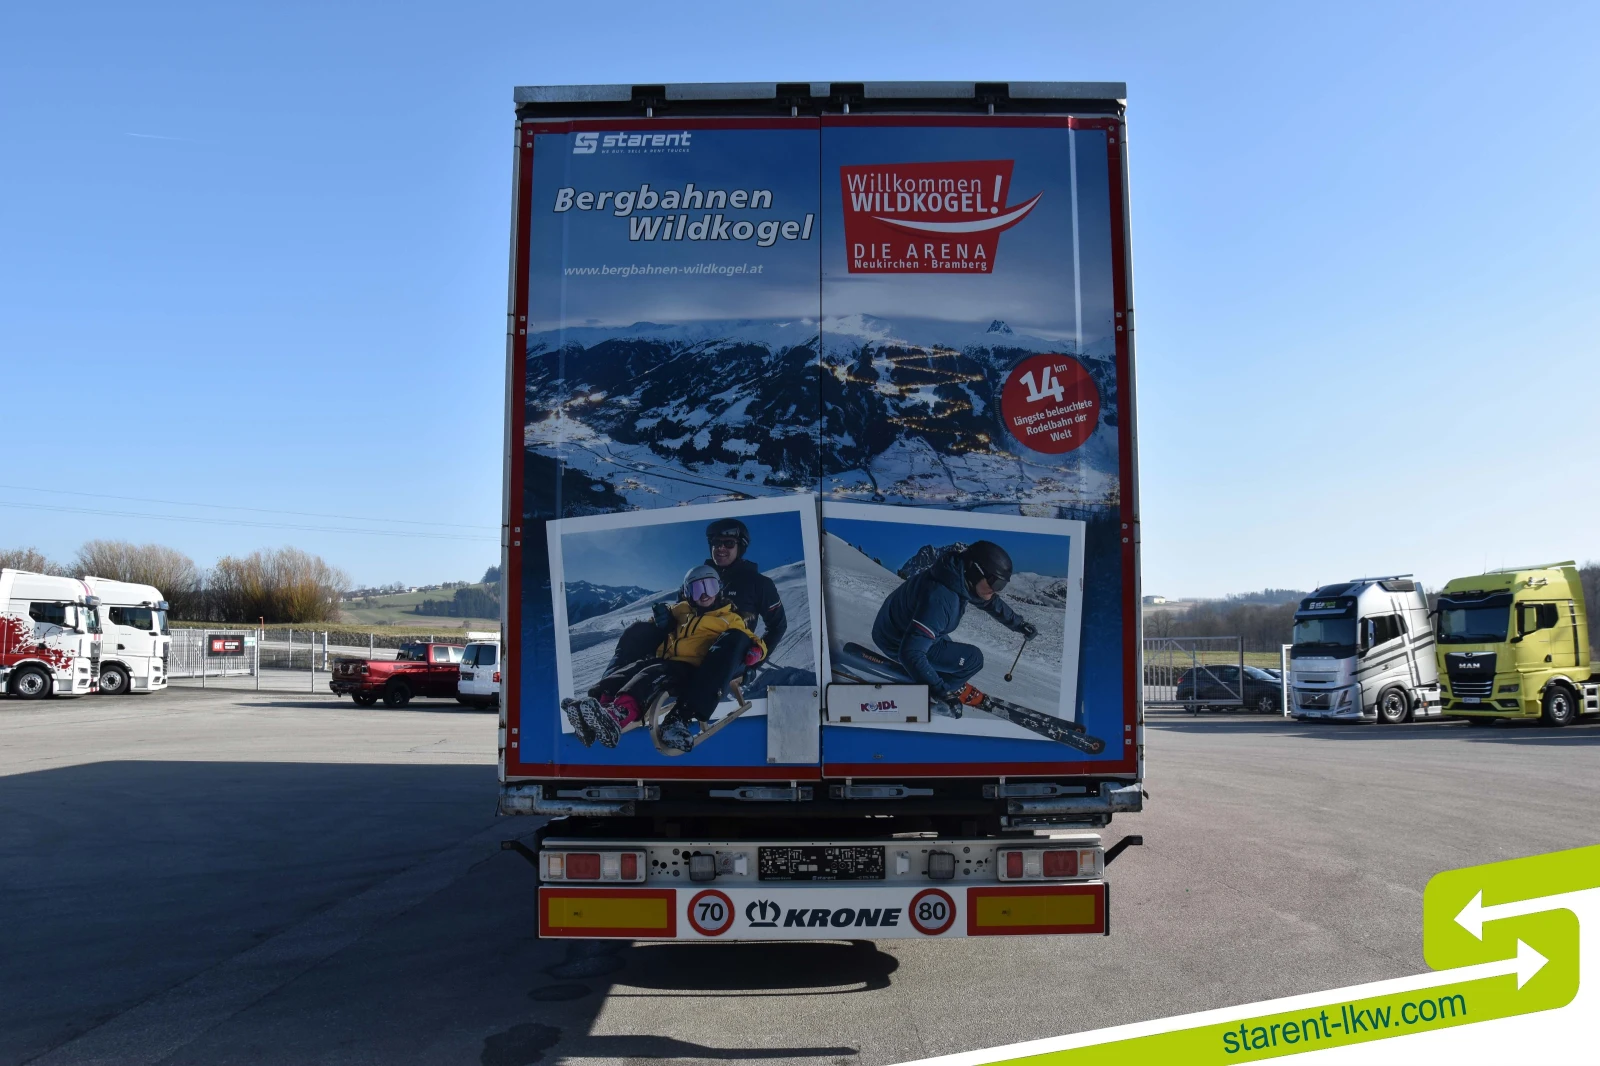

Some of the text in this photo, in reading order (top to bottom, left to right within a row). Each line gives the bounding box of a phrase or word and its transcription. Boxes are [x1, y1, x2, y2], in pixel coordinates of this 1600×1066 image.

[602, 131, 692, 147] starent
[847, 173, 982, 193] Willkommen
[553, 183, 773, 217] Bergbahnen
[629, 213, 815, 247] Wildkogel
[854, 243, 987, 259] DIE ARENA
[564, 263, 763, 277] www.bergbahnen-wildkogel.at
[854, 259, 988, 271] Neukirchen Bramberg
[1019, 364, 1068, 403] 14 km
[1013, 399, 1093, 426] längste beleuchtete
[1026, 413, 1087, 436] Rodelbahn der
[1050, 429, 1072, 442] Welt
[698, 903, 724, 922] 70
[783, 908, 902, 928] KRONE
[918, 902, 946, 921] 80
